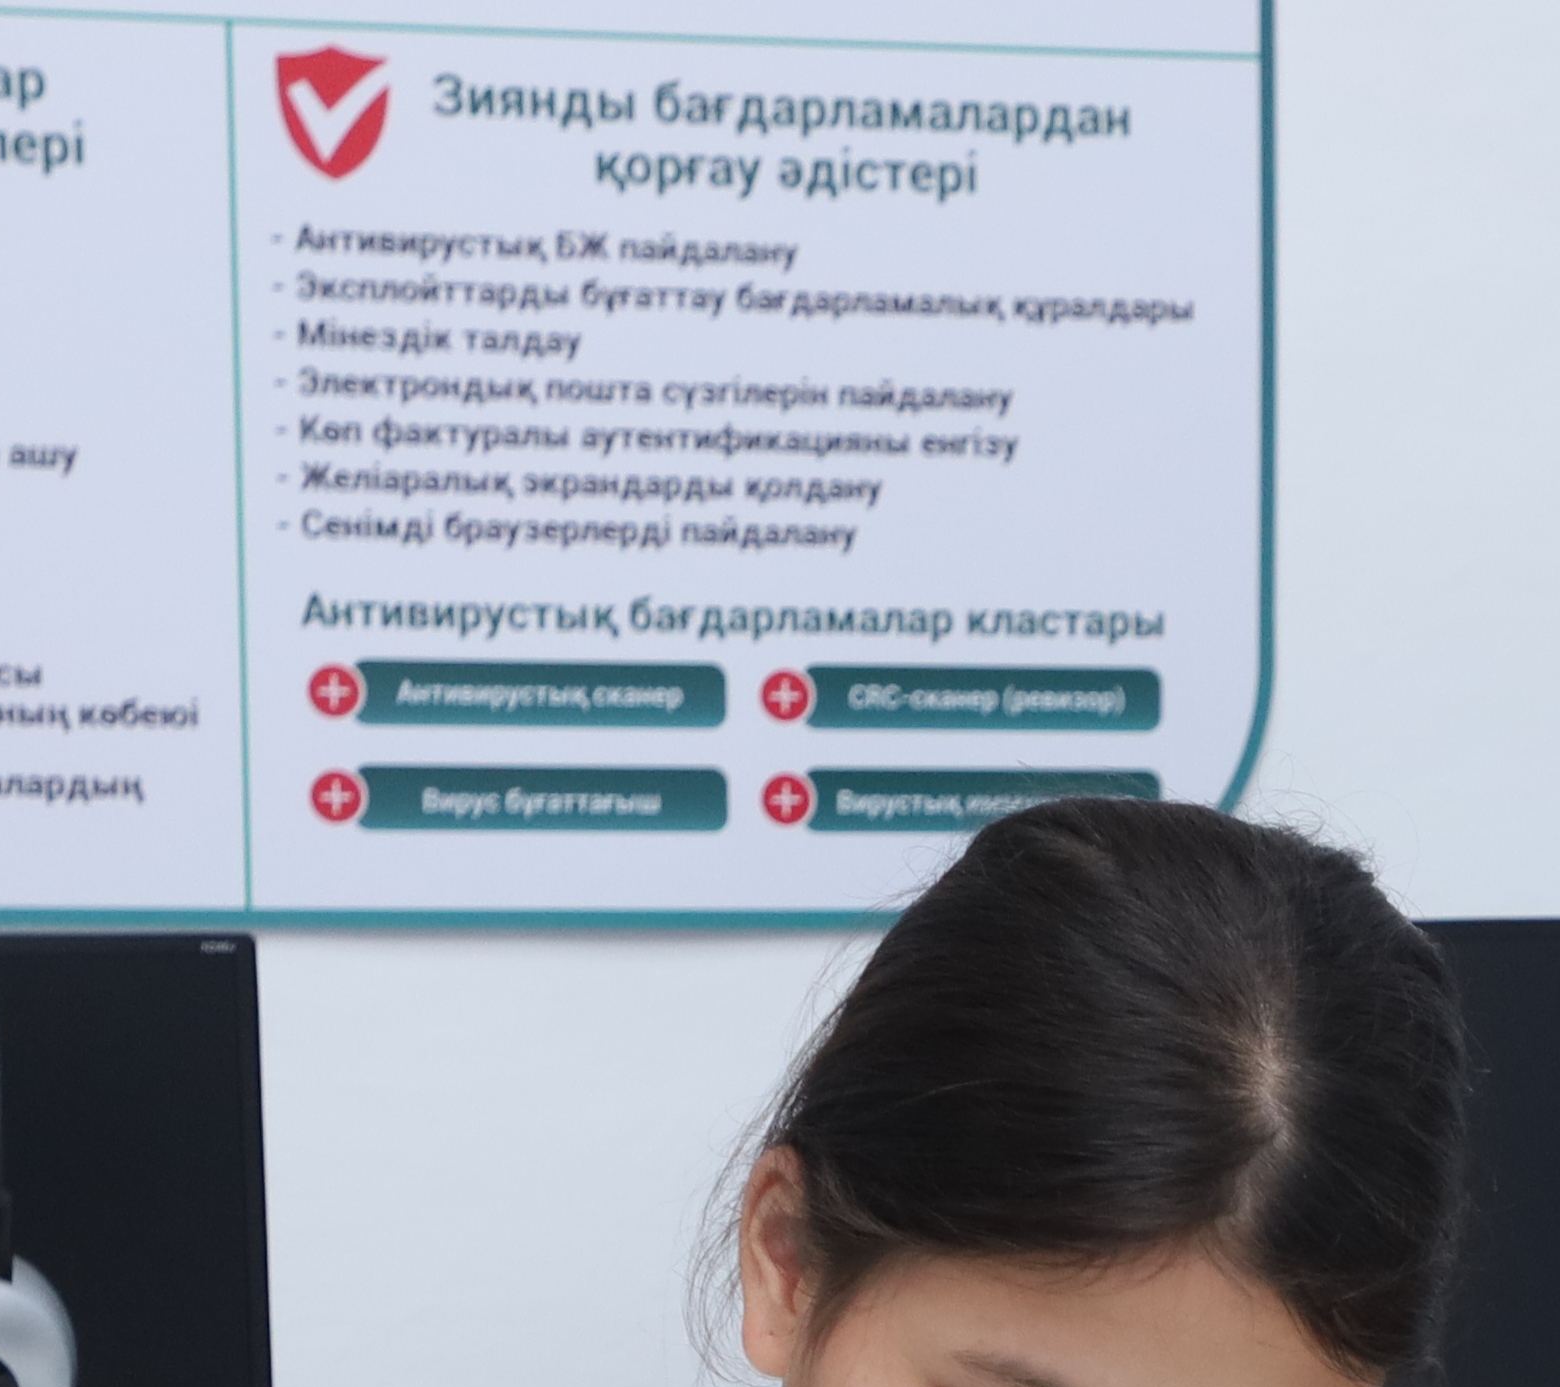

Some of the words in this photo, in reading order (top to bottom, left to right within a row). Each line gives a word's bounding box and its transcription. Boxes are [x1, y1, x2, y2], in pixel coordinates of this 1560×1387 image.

[434, 73, 635, 131] Зиянды
[654, 80, 1131, 148] бағдарламалардан
[596, 152, 762, 200] қорғау
[778, 146, 977, 205] әдістері
[295, 223, 548, 265] Антивирустық
[556, 229, 609, 261] БЖ
[619, 232, 798, 273] пайдалану
[297, 318, 451, 357] Мінездік
[464, 329, 581, 363] талдау
[299, 366, 538, 407] Электрондық
[545, 378, 652, 404] пошта
[661, 381, 829, 413] сүзгілерін
[838, 378, 1013, 419] пайдалану
[9, 444, 78, 477] ашу
[299, 414, 362, 445] Көп
[371, 415, 569, 455] фактуралы
[920, 433, 1018, 464] енгізу
[302, 462, 515, 500] Желіаралық
[524, 472, 734, 505] экрандарды
[745, 477, 882, 509] қолдану
[302, 509, 434, 546] Сенімді
[444, 510, 672, 550] браузерлерді
[681, 515, 857, 554] пайдалану
[301, 591, 620, 640] Антивирустық
[628, 595, 954, 645] бағдарламалар
[966, 609, 1165, 647] кластары
[79, 698, 199, 728] көбеюі
